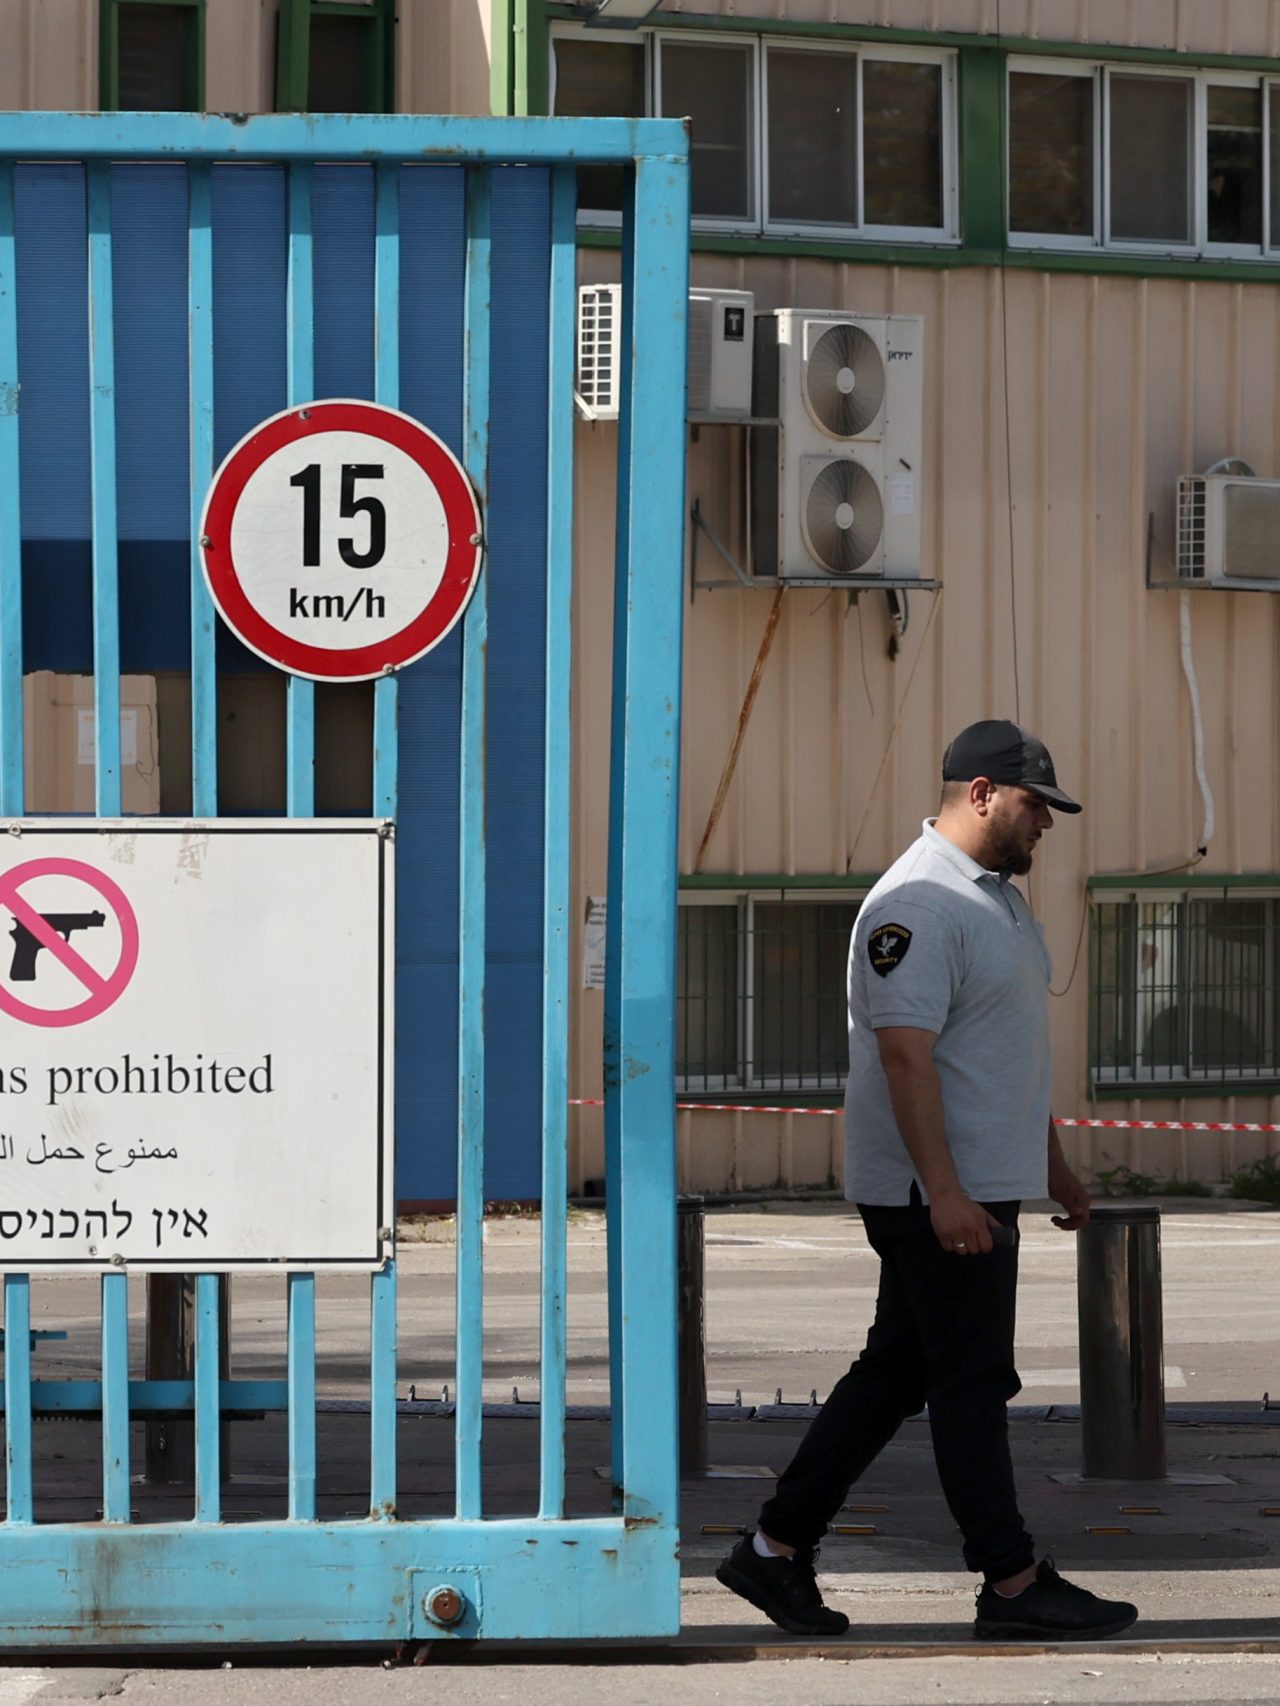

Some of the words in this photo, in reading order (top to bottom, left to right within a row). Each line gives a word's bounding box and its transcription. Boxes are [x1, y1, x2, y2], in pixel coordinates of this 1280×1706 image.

[290, 463, 386, 569] 15
[289, 587, 385, 622] km/h
[47, 1053, 274, 1106] prohibited
[26, 1134, 85, 1165] حمل
[94, 1137, 178, 1175] ممنوع
[152, 1208, 208, 1248] אין
